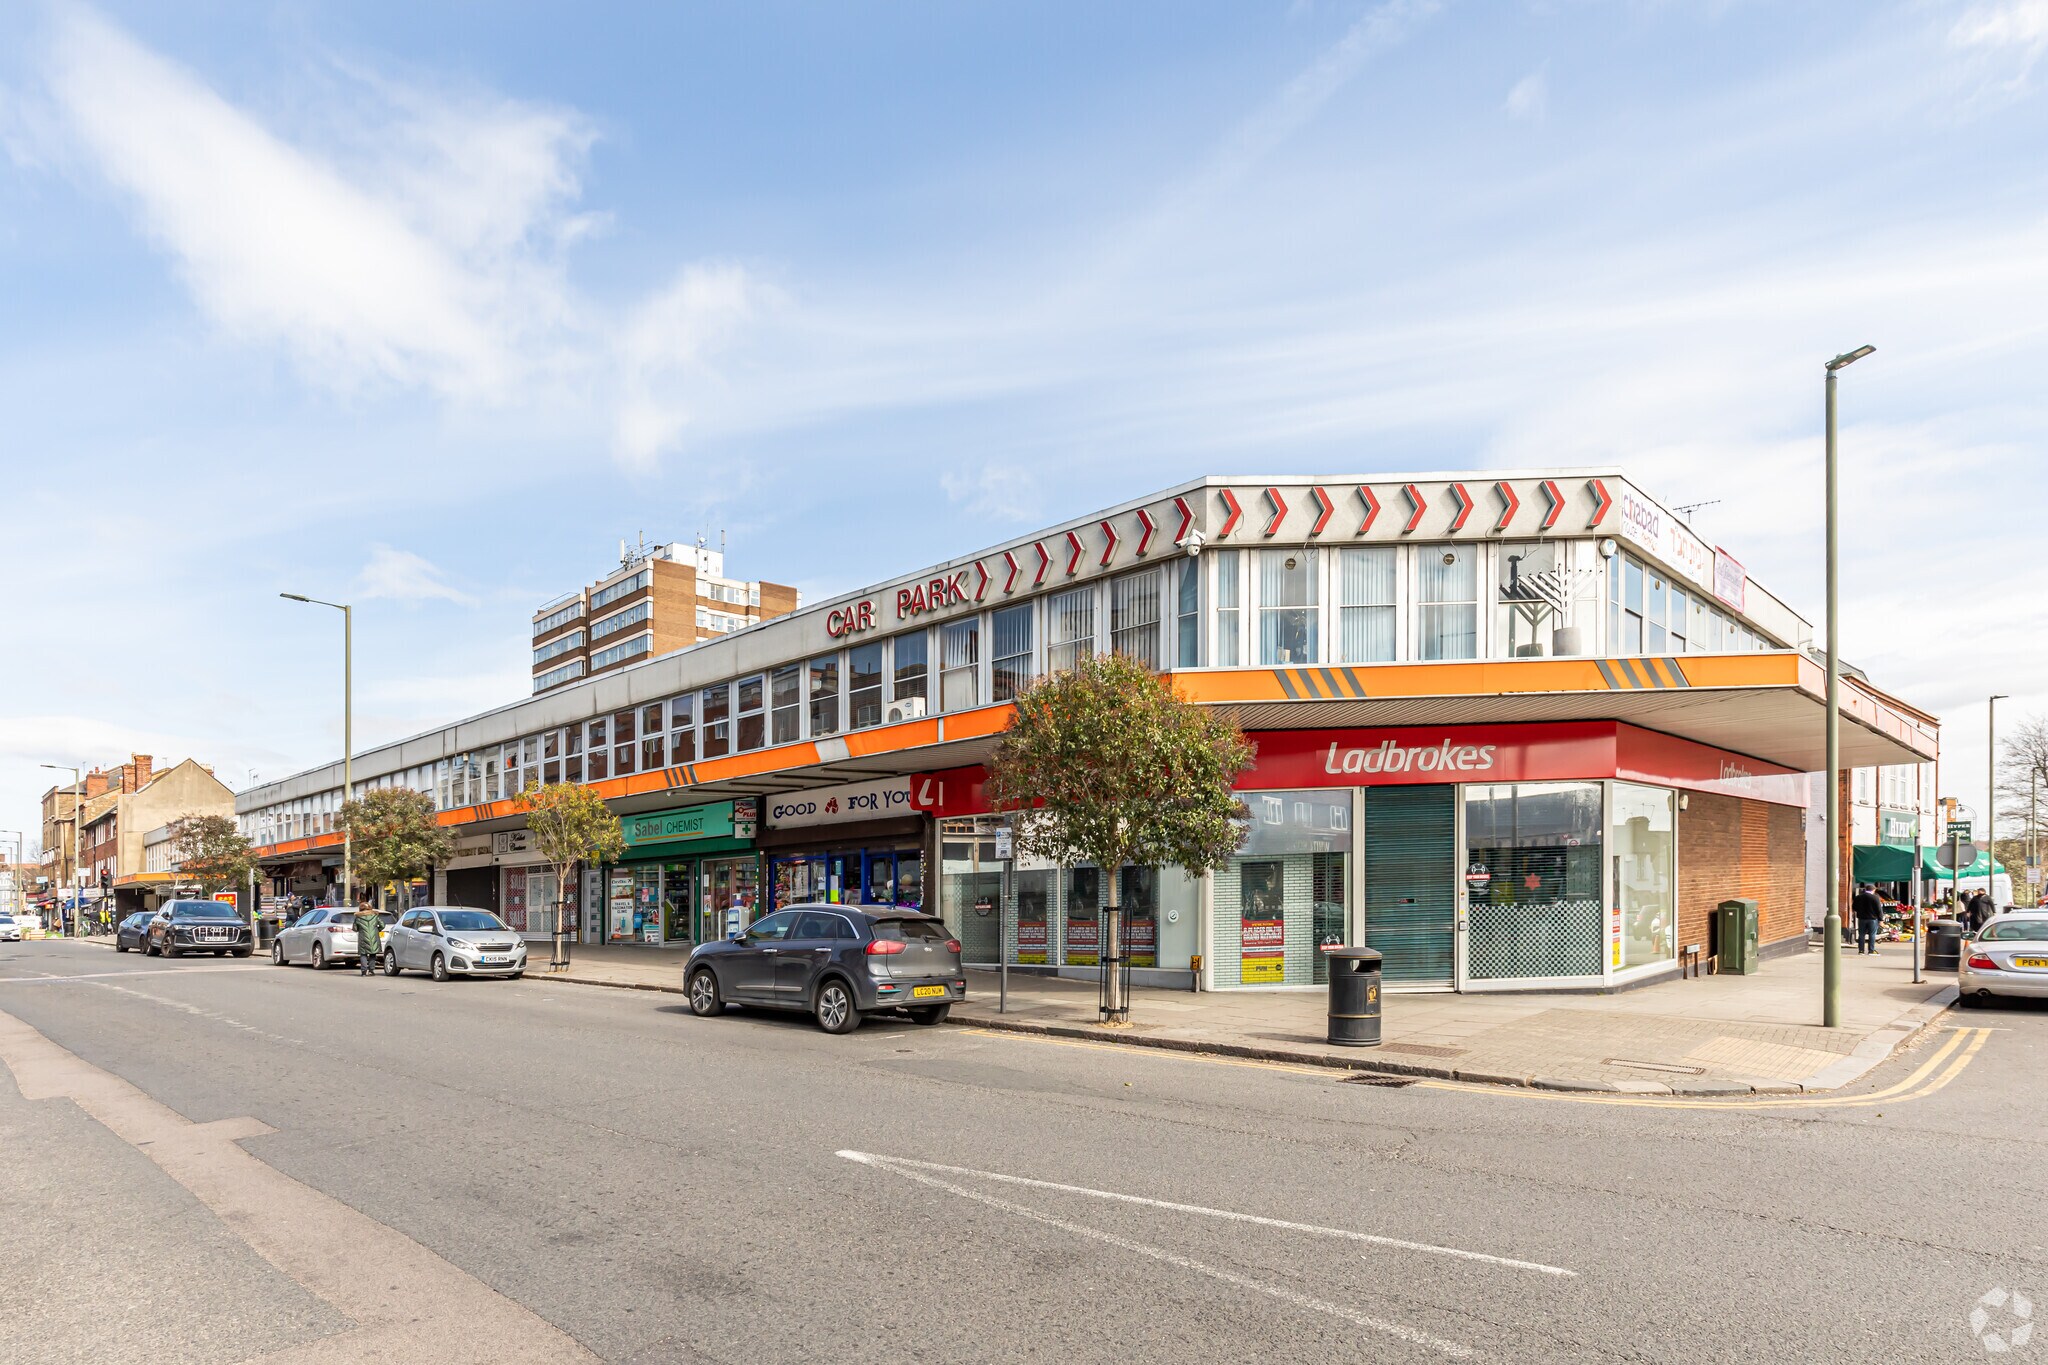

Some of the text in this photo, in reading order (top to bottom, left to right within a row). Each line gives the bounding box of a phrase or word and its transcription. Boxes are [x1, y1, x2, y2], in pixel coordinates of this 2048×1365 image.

[826, 570, 969, 638] CAR PARK
[1324, 738, 1496, 775] Ladbrokes
[773, 802, 816, 820] GOOD
[848, 793, 877, 811] FOR
[634, 817, 704, 837] Sabel CHEMIST
[916, 987, 931, 996] LC20
